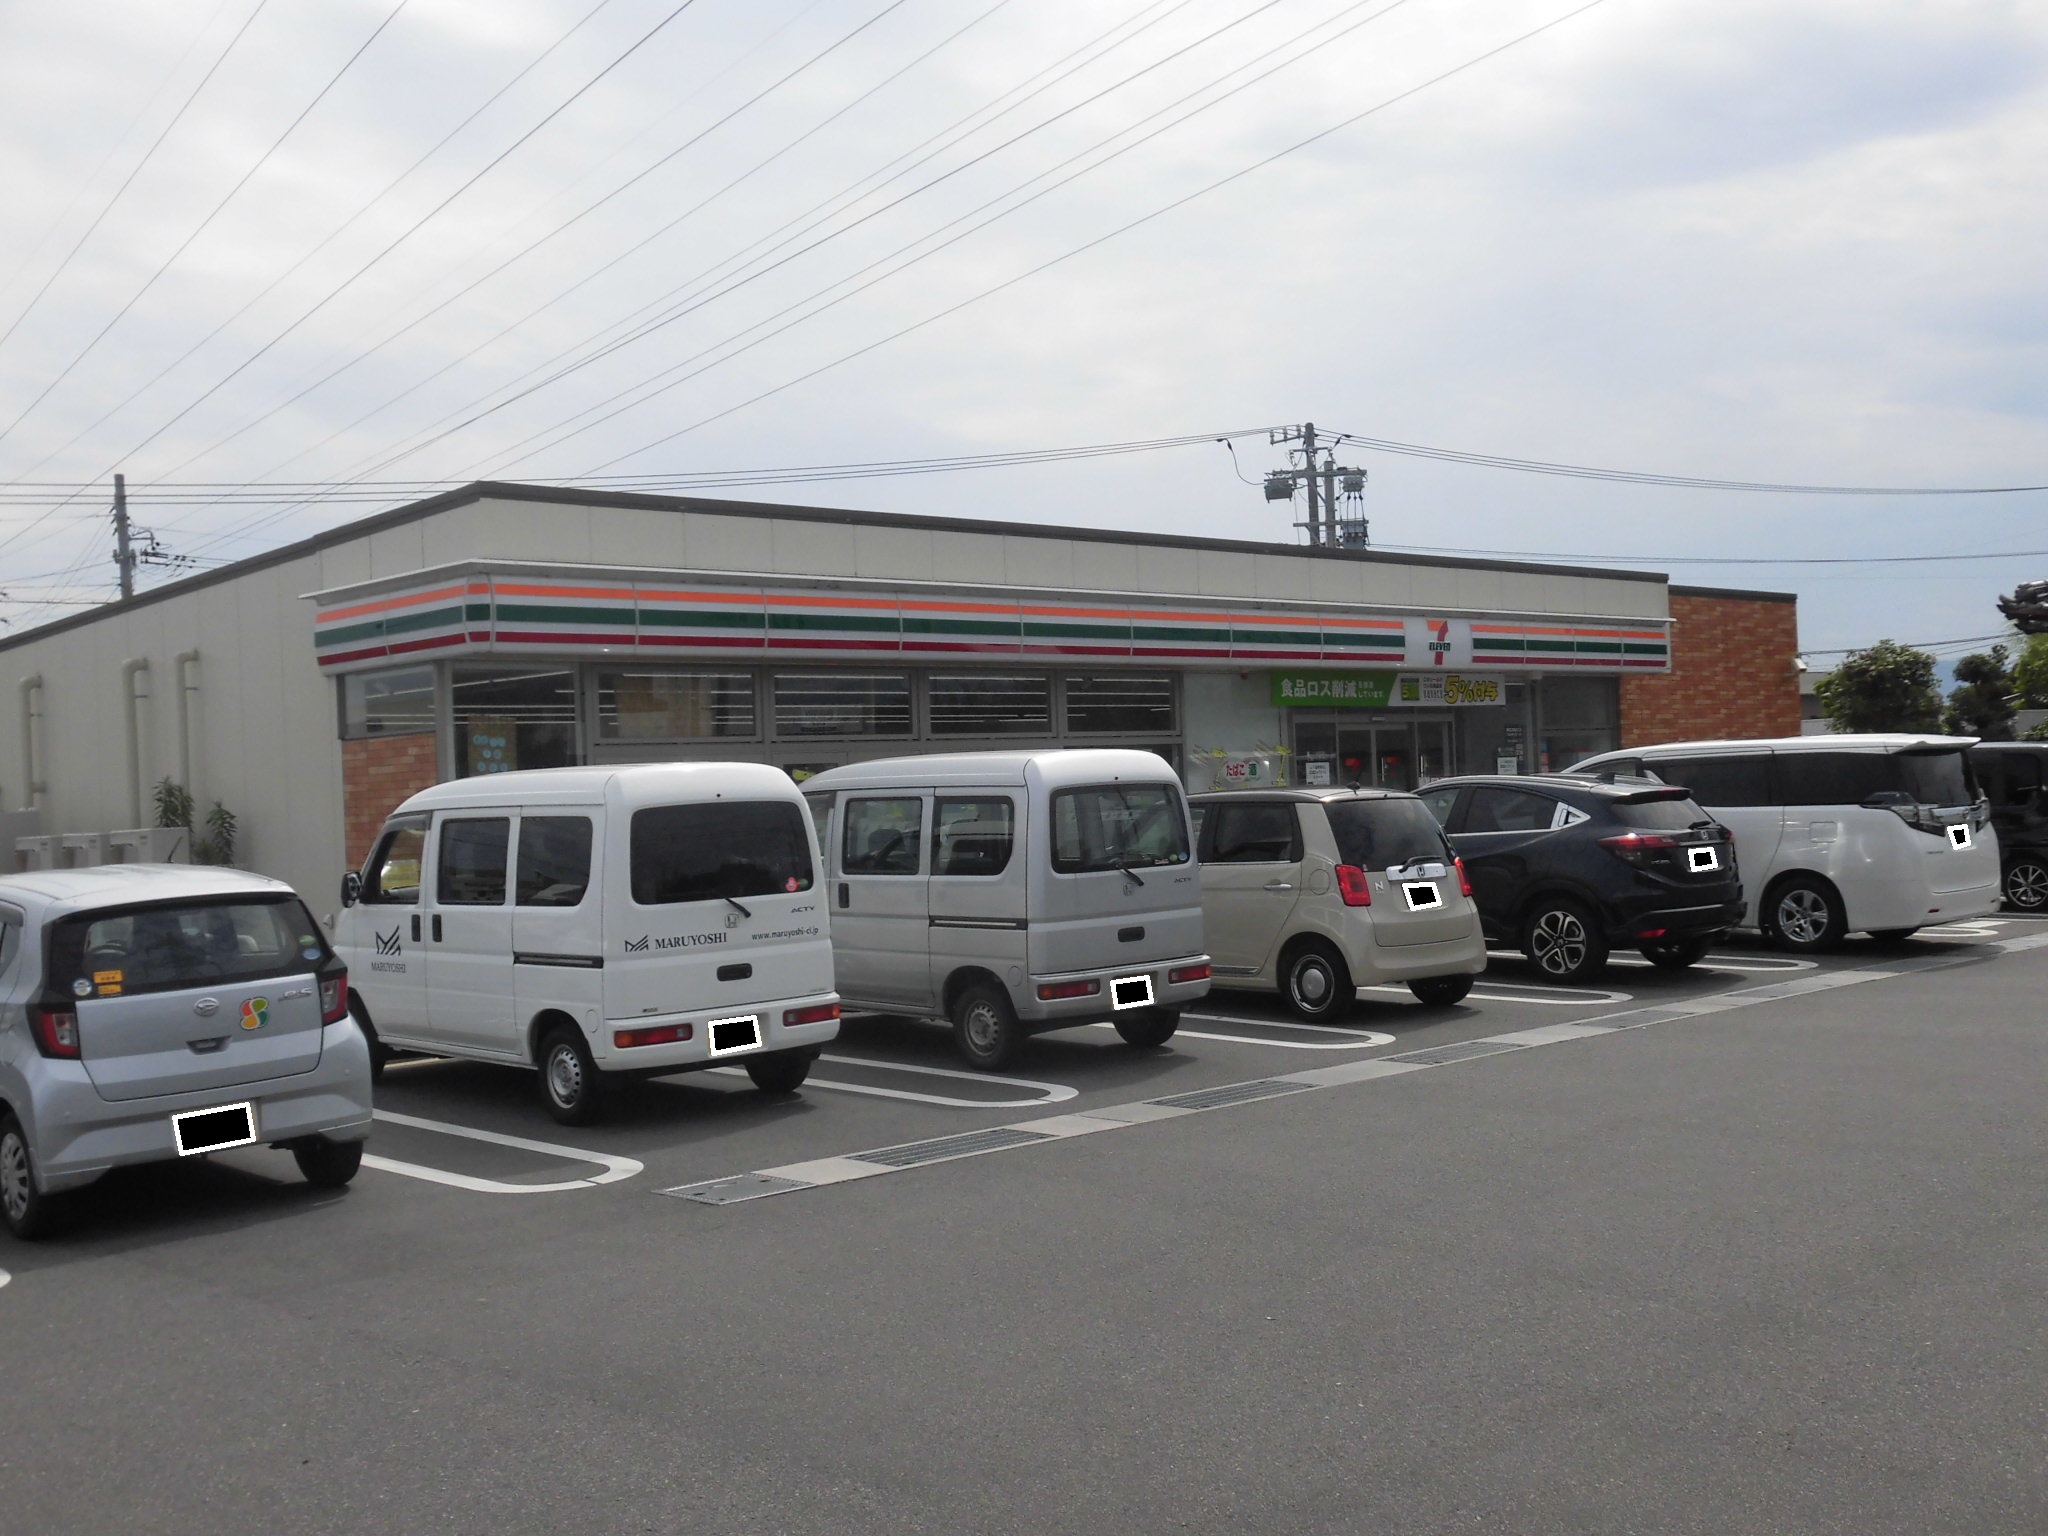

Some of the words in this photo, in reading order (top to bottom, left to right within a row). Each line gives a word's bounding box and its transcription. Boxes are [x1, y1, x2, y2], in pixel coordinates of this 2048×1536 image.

[1281, 678, 1358, 698] 食品ロス削減
[1444, 675, 1498, 704] 5%付与
[1226, 763, 1246, 776] たばこ
[791, 905, 815, 914] ACTY
[655, 932, 728, 950] MARUYOSHI
[752, 926, 819, 941] www.maruyoshi-ci.jp
